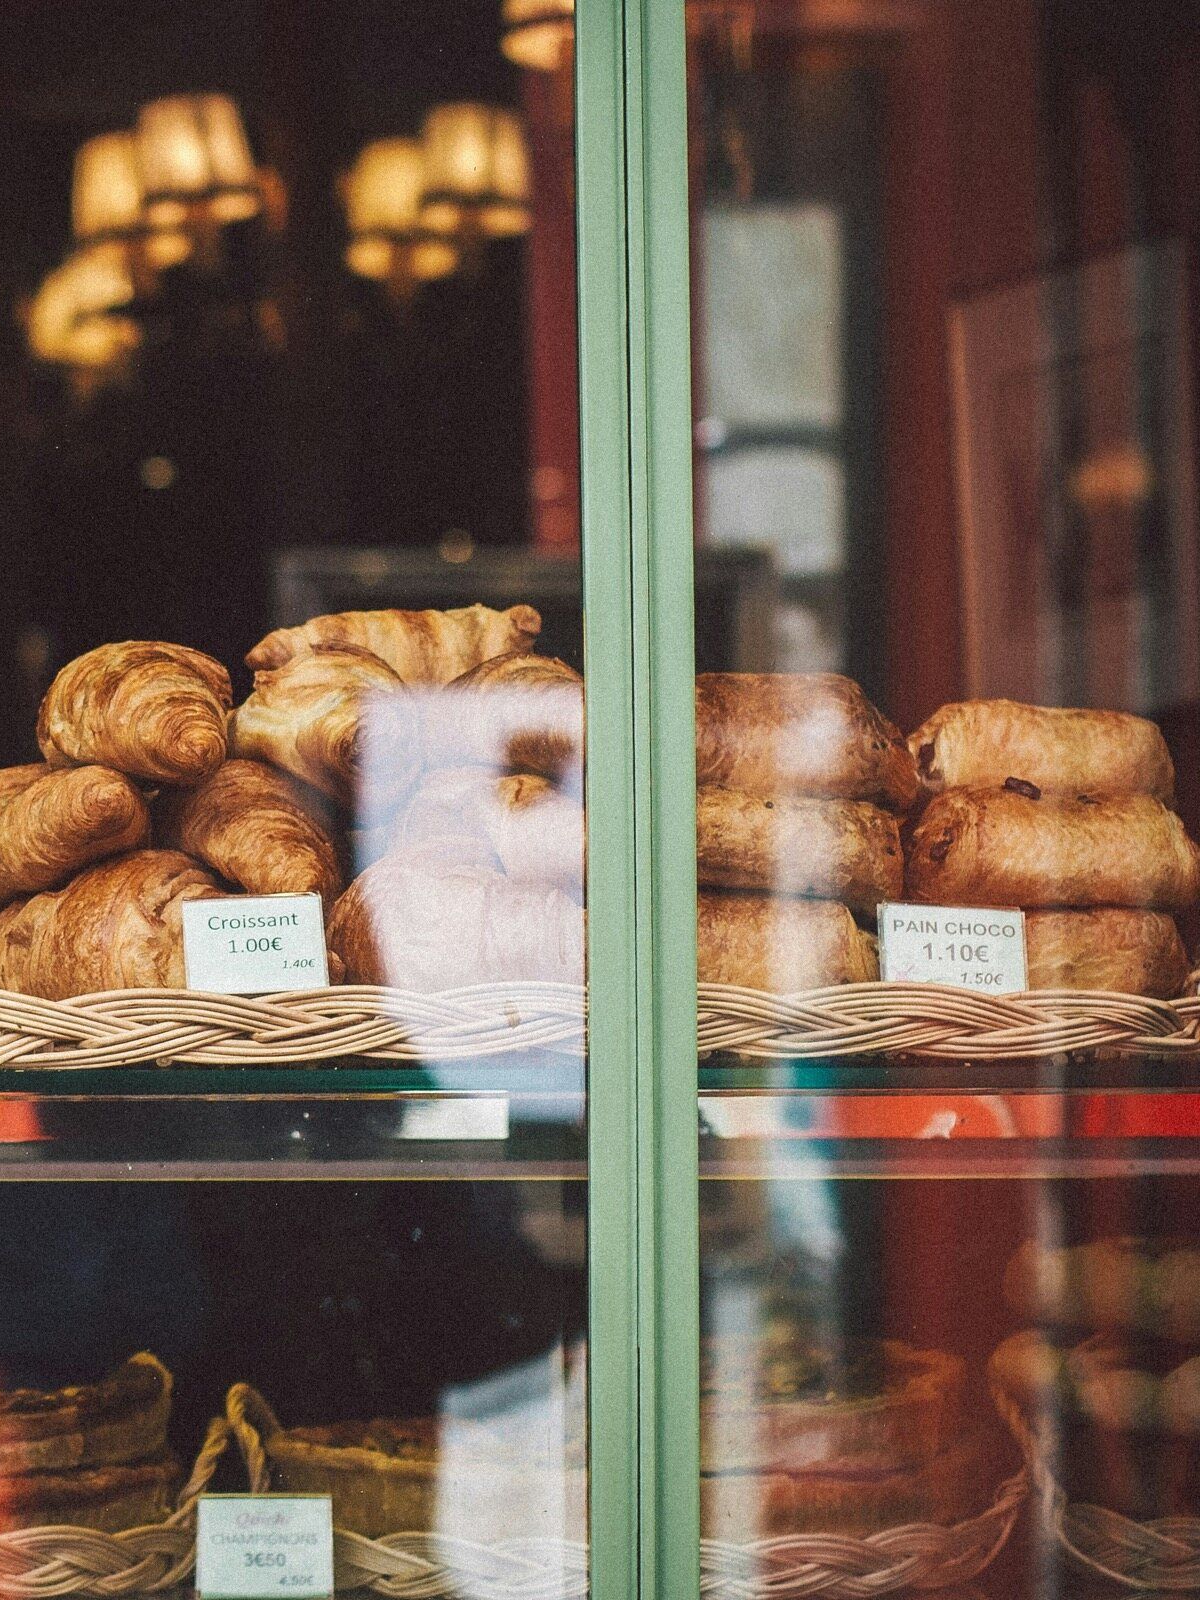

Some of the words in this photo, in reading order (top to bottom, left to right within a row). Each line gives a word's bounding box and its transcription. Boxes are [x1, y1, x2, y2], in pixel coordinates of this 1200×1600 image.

[207, 912, 299, 931] Croissant
[893, 919, 938, 934] PAIN
[944, 921, 1016, 938] CHOCO
[228, 937, 284, 954] 1.00€
[922, 942, 990, 963] 1.10€
[282, 958, 318, 970] 1.40€
[959, 972, 1004, 986] 1.50€
